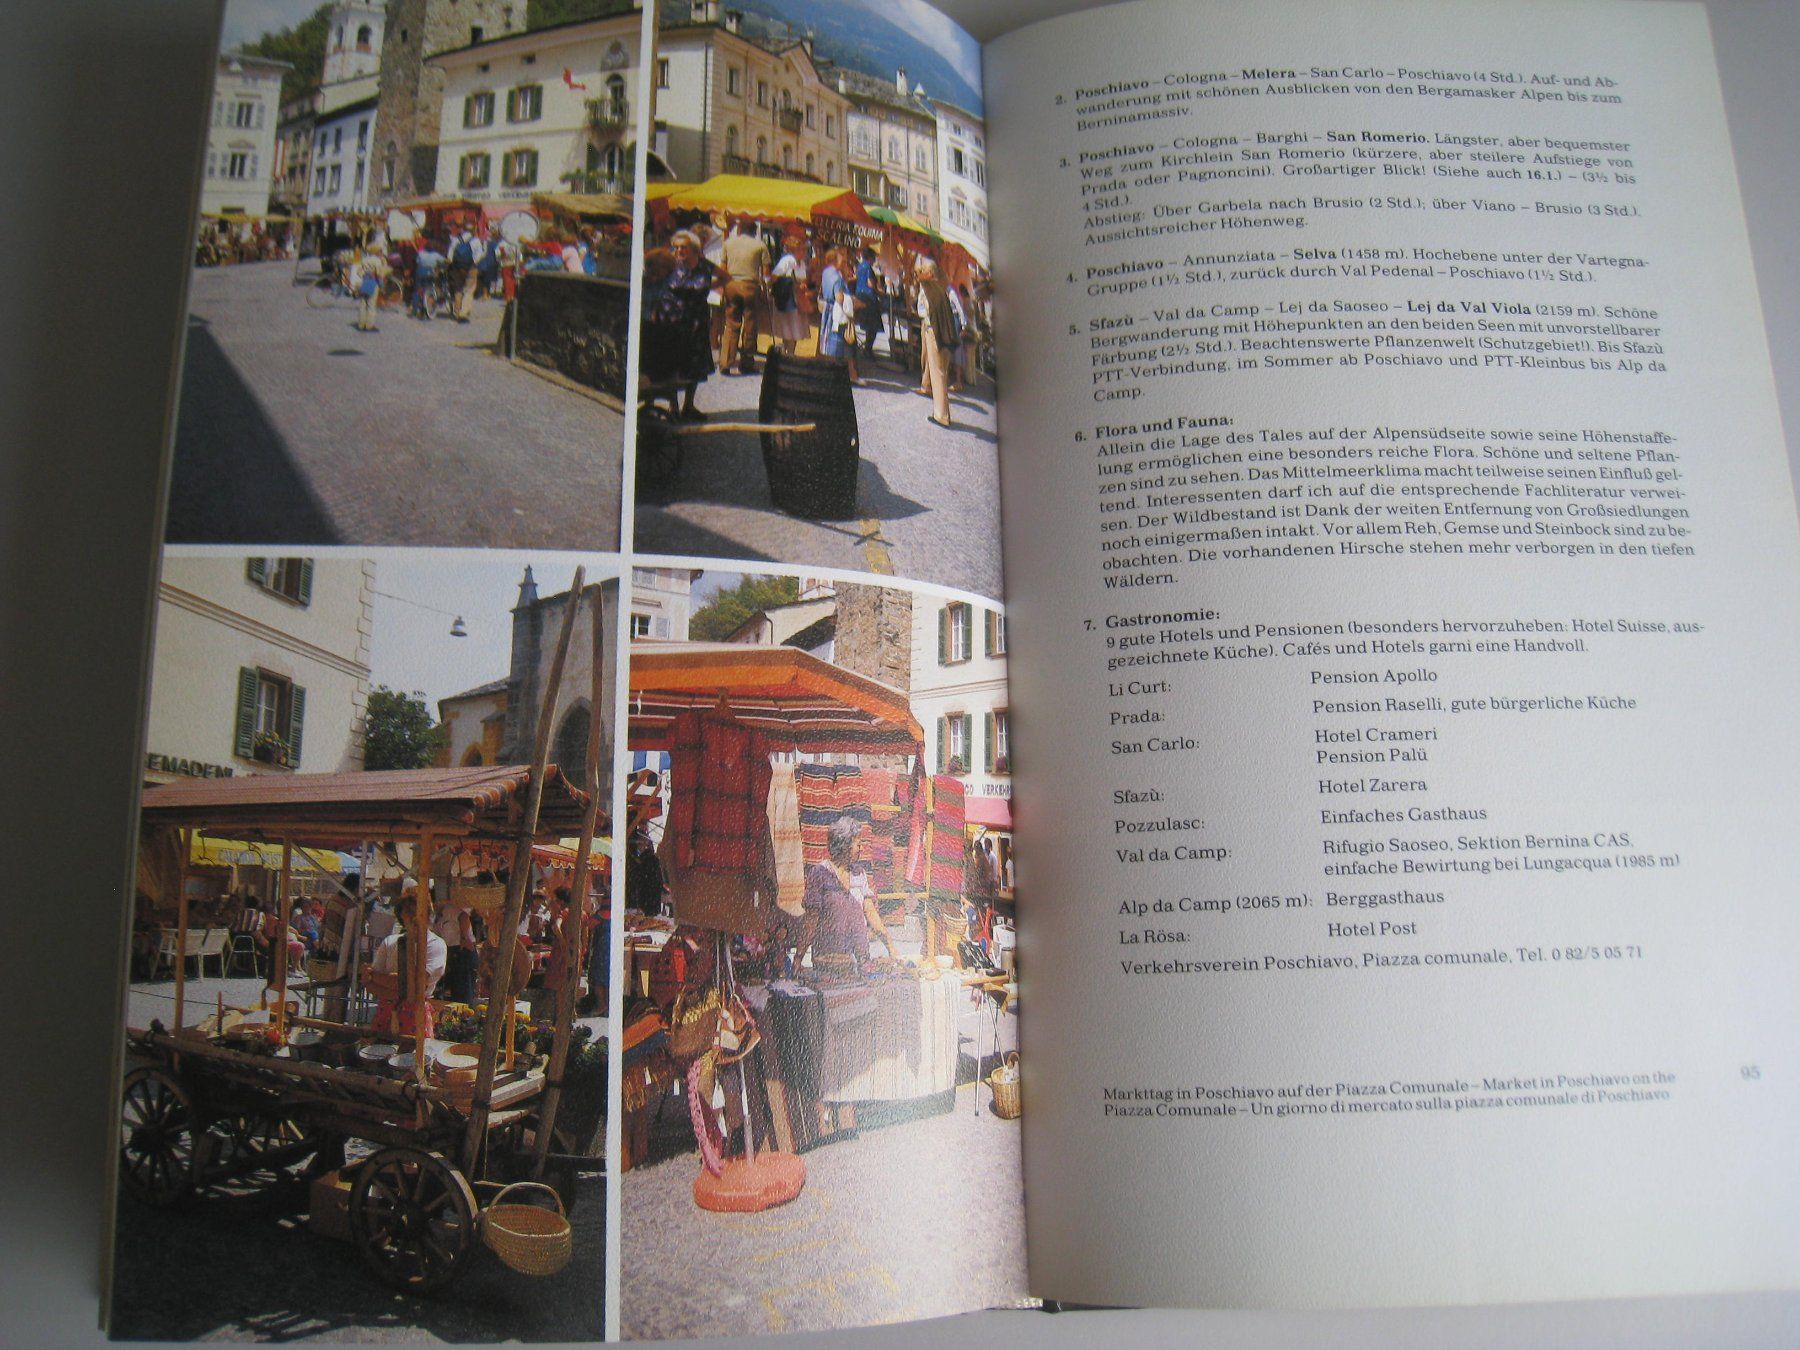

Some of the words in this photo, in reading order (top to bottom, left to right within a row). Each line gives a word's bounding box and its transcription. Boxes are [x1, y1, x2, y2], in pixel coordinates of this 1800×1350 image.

[1075, 95, 1161, 115] wanderung
[1165, 90, 1191, 101] mit
[1196, 87, 1259, 97] schönen
[1265, 83, 1350, 94] Ausblicken
[1385, 83, 1413, 94] den
[1417, 84, 1516, 98] Bergamasker
[1520, 89, 1564, 102] Alpen
[1566, 91, 1588, 102] bis
[1591, 94, 1622, 103] zum
[1080, 167, 1113, 179] Weg
[1120, 161, 1153, 172] zum
[1161, 152, 1233, 166] Kirchlein
[1241, 149, 1270, 160] San
[1278, 148, 1345, 159] Romerio
[1429, 149, 1462, 160] aber
[1469, 151, 1525, 163] steilere
[1532, 149, 1601, 168] Aufstiege
[1607, 159, 1634, 167] von
[1085, 221, 1217, 245] Aussichtsreicher
[1220, 217, 1308, 228] Höhenweg.
[1092, 361, 1231, 384] PTT-Verbindung,
[1237, 358, 1258, 369] im
[1264, 355, 1334, 367] Sommer
[1339, 353, 1358, 365] ab
[1364, 353, 1443, 365] Poschiavo
[1448, 354, 1478, 366] und
[1484, 355, 1586, 369] PTT-Kleinbus
[1589, 358, 1612, 370] bis
[1617, 359, 1643, 374] Alp
[1648, 360, 1667, 372] da
[1093, 387, 1145, 402] Camp.
[1075, 431, 1087, 442] 6.
[1095, 425, 1138, 438] Flora
[1142, 418, 1173, 432] und
[1177, 416, 1234, 428] Fauna:
[1097, 462, 1133, 475] lung
[1138, 452, 1243, 470] ermöglichen
[1248, 449, 1283, 461] eine
[1288, 446, 1373, 459] besonders
[1378, 445, 1428, 457] reiche
[1482, 445, 1539, 458] Schöne
[1543, 448, 1573, 459] und
[1577, 448, 1632, 461] seltene
[1635, 449, 1680, 462] Pflan-
[1102, 554, 1182, 570] obachten.
[1188, 549, 1217, 562] Die
[1222, 544, 1335, 558] vorhandenen
[1340, 541, 1404, 554] Hirsche
[1409, 541, 1463, 553] stehen
[1468, 541, 1511, 553] mehr
[1515, 541, 1595, 556] verborgen
[1599, 542, 1614, 554] in
[1618, 542, 1648, 555] den
[1651, 543, 1696, 555] tiefen
[1103, 573, 1178, 588] Wäldern.
[1083, 620, 1097, 631] 7.
[1105, 608, 1220, 628] Gastronomie:
[1106, 636, 1115, 648] 9
[1119, 634, 1155, 649] gute
[1159, 628, 1214, 643] Hotels
[1217, 625, 1251, 639] und
[1255, 623, 1344, 637] Pensionen
[1347, 620, 1439, 633] (besonders
[1442, 619, 1568, 632] hervorzuheben:
[1571, 619, 1614, 632] Hotel
[1672, 622, 1705, 632] aus-
[1107, 650, 1209, 671] gezeichnete
[1213, 644, 1278, 659] Küche).
[1282, 642, 1331, 656] Cafés
[1335, 640, 1367, 654] und
[1371, 640, 1425, 653] Hotels
[1429, 640, 1472, 655] garni
[1475, 640, 1510, 652] eine
[1513, 638, 1588, 651] Handvoll.
[1310, 671, 1379, 684] Pension
[1383, 668, 1438, 685] Apollo
[1108, 683, 1124, 696] Li
[1127, 680, 1171, 694] Curt:
[1312, 700, 1382, 713] Pension
[1384, 697, 1446, 711] Raselli,
[1451, 698, 1486, 713] gute
[1490, 696, 1584, 712] bürgerliche
[1586, 696, 1637, 709] Küche
[1110, 709, 1165, 725] Prada:
[1314, 728, 1361, 742] Hotel
[1365, 727, 1438, 741] Crameri
[1111, 741, 1143, 754] San
[1146, 736, 1200, 751] Carlo:
[1316, 750, 1385, 763] Pension
[1390, 748, 1428, 761] Palü
[1318, 779, 1365, 793] Hotel
[1369, 778, 1428, 792] Zarera
[1113, 788, 1165, 804] Sfazù:
[1320, 809, 1404, 823] Einfaches
[1407, 807, 1487, 821] Gasthaus
[1114, 817, 1205, 833] Pozzulasc:
[1322, 839, 1385, 855] Rifugio
[1388, 838, 1453, 851] Saoseo,
[1457, 836, 1521, 850] Sektion
[1525, 834, 1590, 848] Bernina
[1115, 849, 1144, 862] Val
[1148, 848, 1170, 861] da
[1174, 846, 1232, 861] Camp:
[1324, 861, 1398, 875] einfache
[1403, 859, 1491, 874] Bewirtung
[1494, 857, 1519, 870] bei
[1523, 856, 1612, 872] Lungacqua
[1615, 855, 1656, 867] (1985
[1659, 853, 1680, 866] m)
[1118, 900, 1148, 916] Alp
[1152, 899, 1174, 912] da
[1178, 897, 1231, 913] Camp
[1236, 896, 1280, 909] (2065
[1284, 893, 1313, 907] m):
[1326, 891, 1445, 908] Berggasthaus
[1119, 930, 1140, 944] La
[1144, 929, 1190, 943] Rösa:
[1327, 922, 1375, 937] Hotel
[1380, 921, 1417, 935] Post
[1120, 958, 1259, 974] Verkehrsverein
[1263, 955, 1358, 969] Poschiavo,
[1362, 953, 1421, 966] Piazza
[1424, 949, 1512, 964] comunale,
[1515, 947, 1547, 961] Tel.
[1551, 948, 1561, 960] 0
[1565, 947, 1600, 960] 82/5
[1603, 946, 1622, 959] 05
[1626, 945, 1642, 958] 71
[1104, 1104, 1154, 1116] Piazza
[1155, 1100, 1237, 1116] Comunale
[1250, 1102, 1274, 1115] Un
[1276, 1104, 1327, 1117] giorno
[1330, 1100, 1345, 1113] di
[1347, 1100, 1413, 1112] mercato
[1415, 1097, 1452, 1110] sulla
[1454, 1097, 1504, 1111] piazza
[1505, 1092, 1578, 1106] comunale
[1580, 1090, 1596, 1103] di
[1597, 1089, 1670, 1102] Poschiavo
